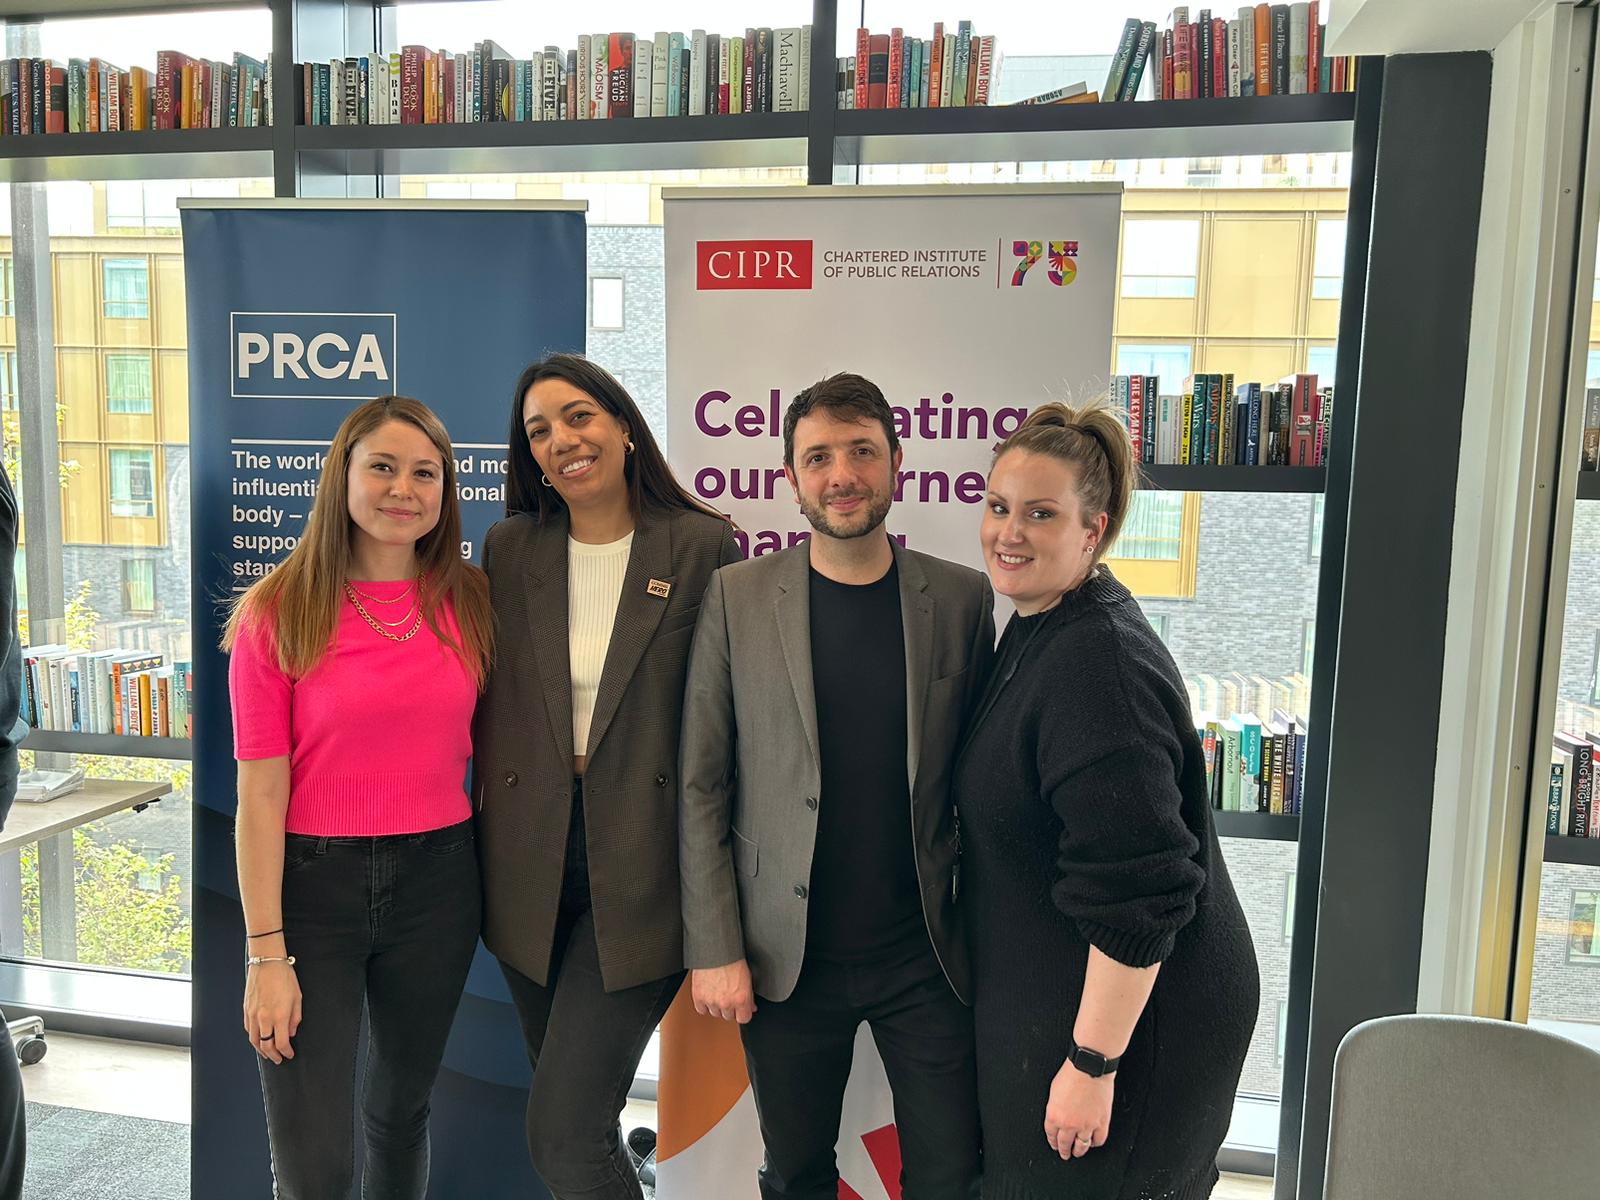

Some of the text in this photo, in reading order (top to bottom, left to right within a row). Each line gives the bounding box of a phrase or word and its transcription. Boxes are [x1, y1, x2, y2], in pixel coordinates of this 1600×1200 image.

[979, 38, 992, 76] WILLIAM
[1132, 25, 1152, 69] SORROWLAND
[595, 58, 604, 100] MAOISM
[779, 32, 793, 112] Machiavelli
[109, 73, 117, 106] WILLIAM
[346, 85, 356, 116] FIVE
[545, 76, 555, 109] FIVE
[707, 249, 802, 282] CIPR
[823, 248, 987, 271] CHARTERED INSTITUTE
[823, 263, 980, 285] OF PUBLIC RELATIONS
[1012, 240, 1079, 286] 75
[238, 332, 389, 380] PRCA
[1194, 382, 1203, 391] In
[1326, 390, 1331, 400] BE
[1131, 377, 1140, 441] THE KEY MAN
[1193, 404, 1202, 428] Wars
[231, 451, 271, 469] The
[232, 478, 320, 497] influenti
[695, 467, 785, 501] our
[232, 504, 283, 527] body
[232, 535, 302, 554] suppo
[129, 678, 137, 709] WILLIAM
[1227, 736, 1236, 774] Arbornaut
[1273, 740, 1282, 800] THE WHITE BIRCH
[1579, 748, 1589, 775] LONG
[1576, 778, 1587, 811] BRIGHT
